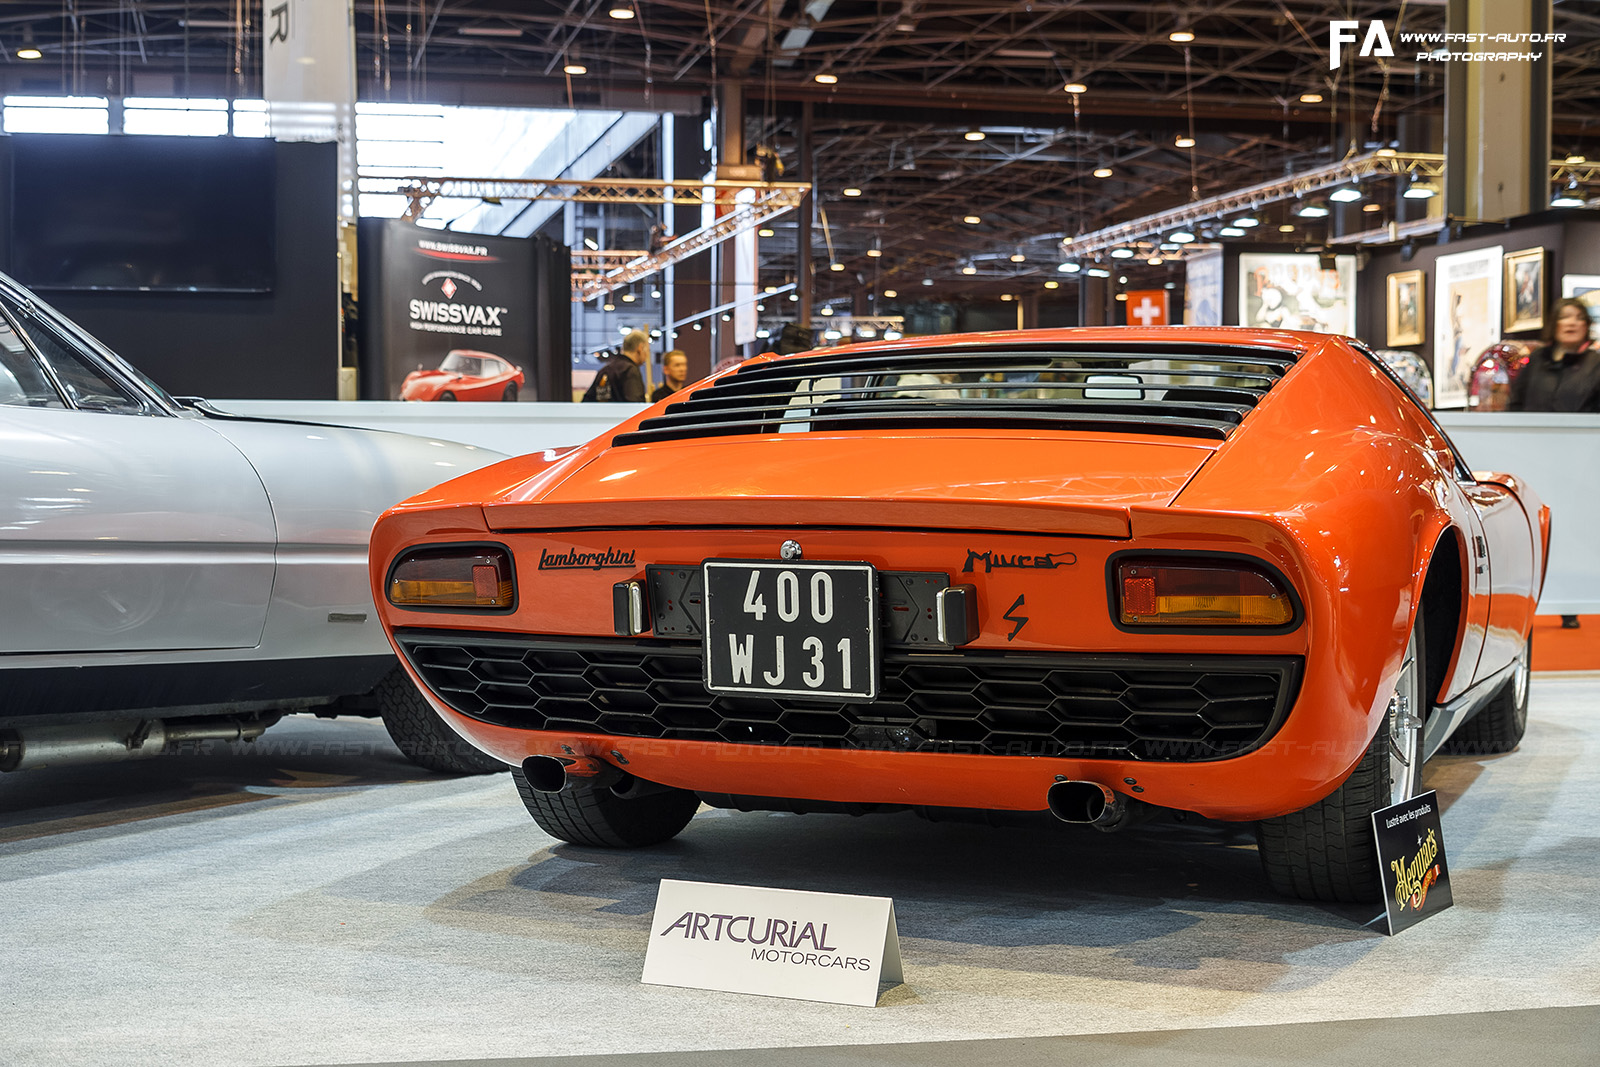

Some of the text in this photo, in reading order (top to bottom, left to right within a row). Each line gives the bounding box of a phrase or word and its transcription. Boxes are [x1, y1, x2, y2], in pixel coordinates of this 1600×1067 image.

[409, 299, 502, 326] SWISSVAX
[743, 570, 834, 624] 400
[728, 633, 852, 689] WJ 31
[751, 948, 871, 971] MOTORCARS
